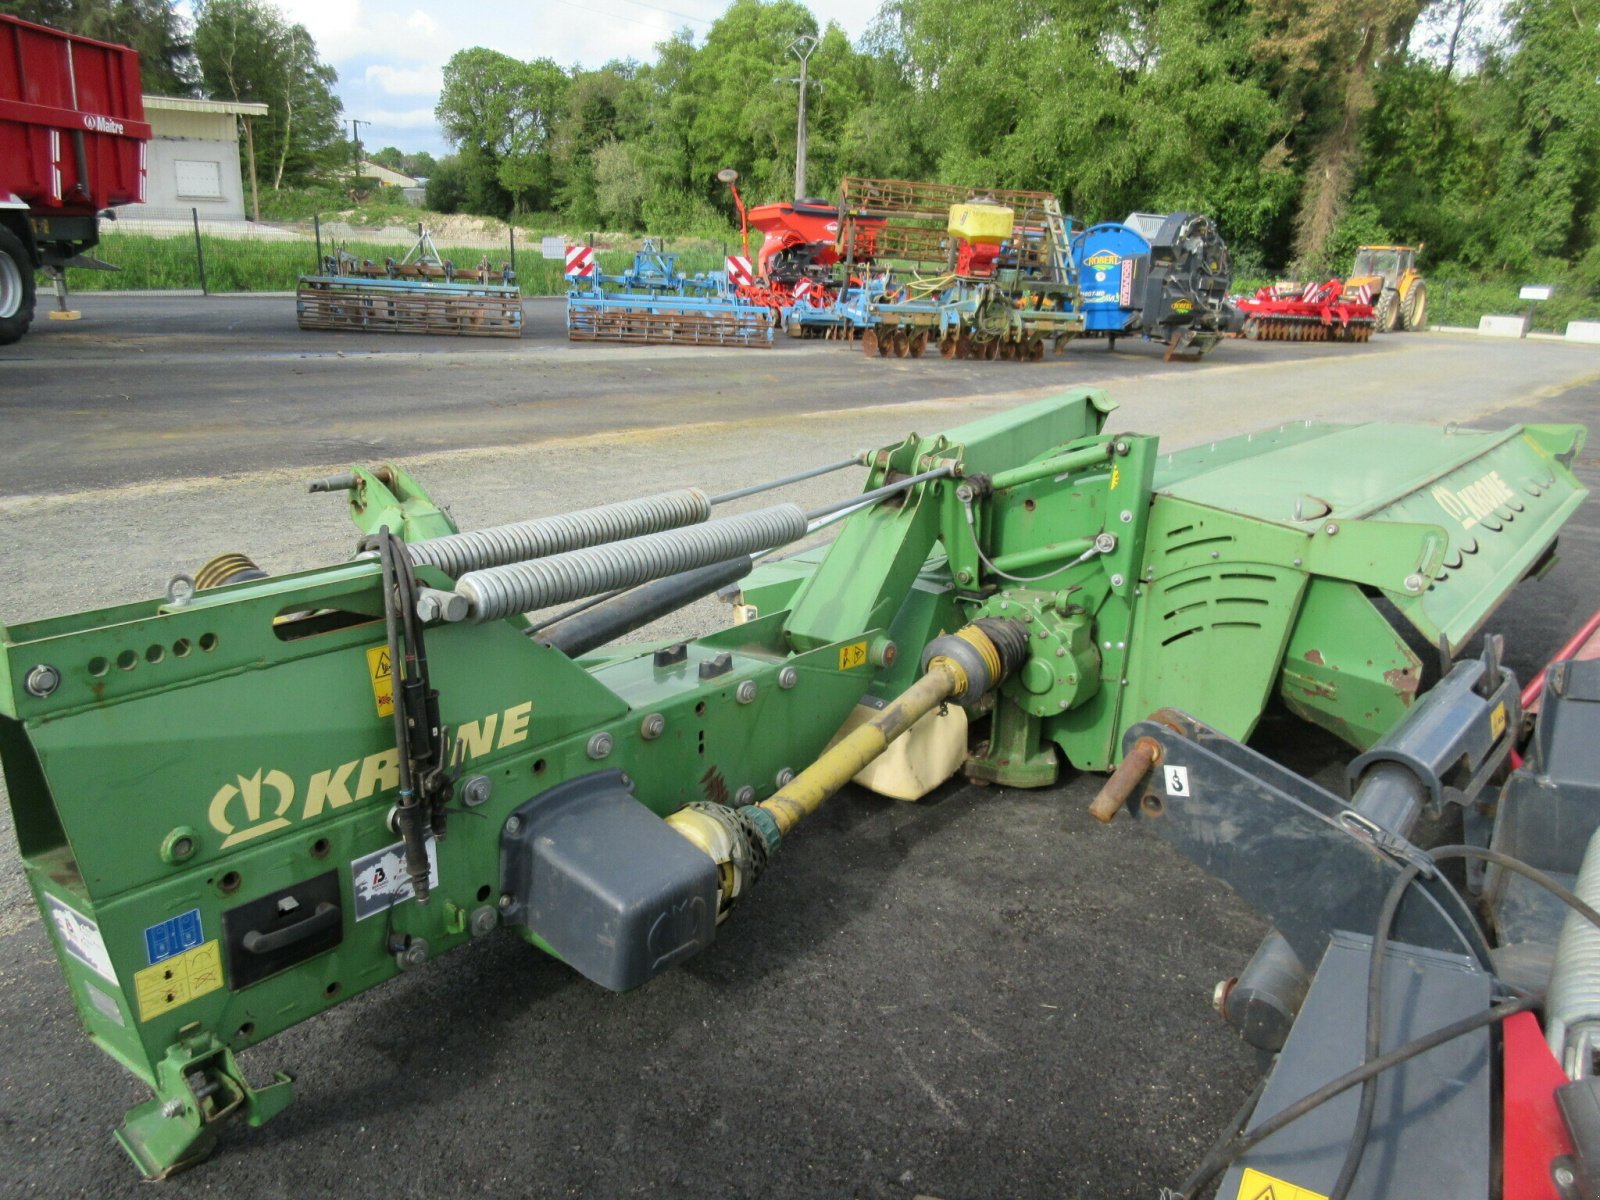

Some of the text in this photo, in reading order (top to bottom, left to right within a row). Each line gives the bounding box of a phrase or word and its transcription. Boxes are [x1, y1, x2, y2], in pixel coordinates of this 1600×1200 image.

[1088, 255, 1119, 266] ROBERT
[1456, 470, 1515, 521] KRONE
[302, 701, 532, 820] KRNE
